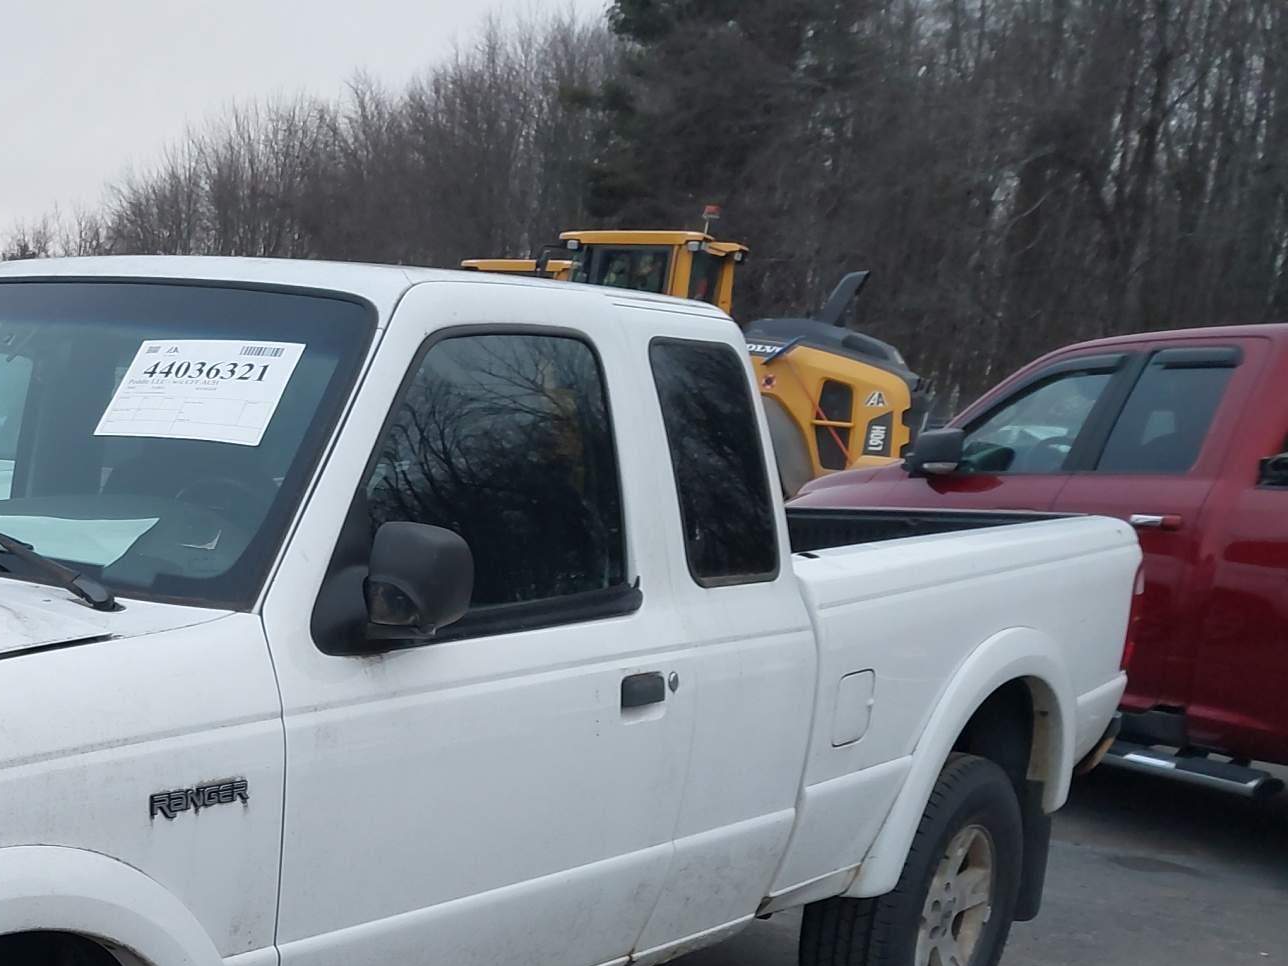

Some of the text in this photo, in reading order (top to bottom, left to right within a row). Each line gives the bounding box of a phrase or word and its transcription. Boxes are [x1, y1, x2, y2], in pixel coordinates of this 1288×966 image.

[143, 360, 272, 382] 44036321
[867, 425, 887, 451] L90H
[150, 780, 249, 819] RANGER
